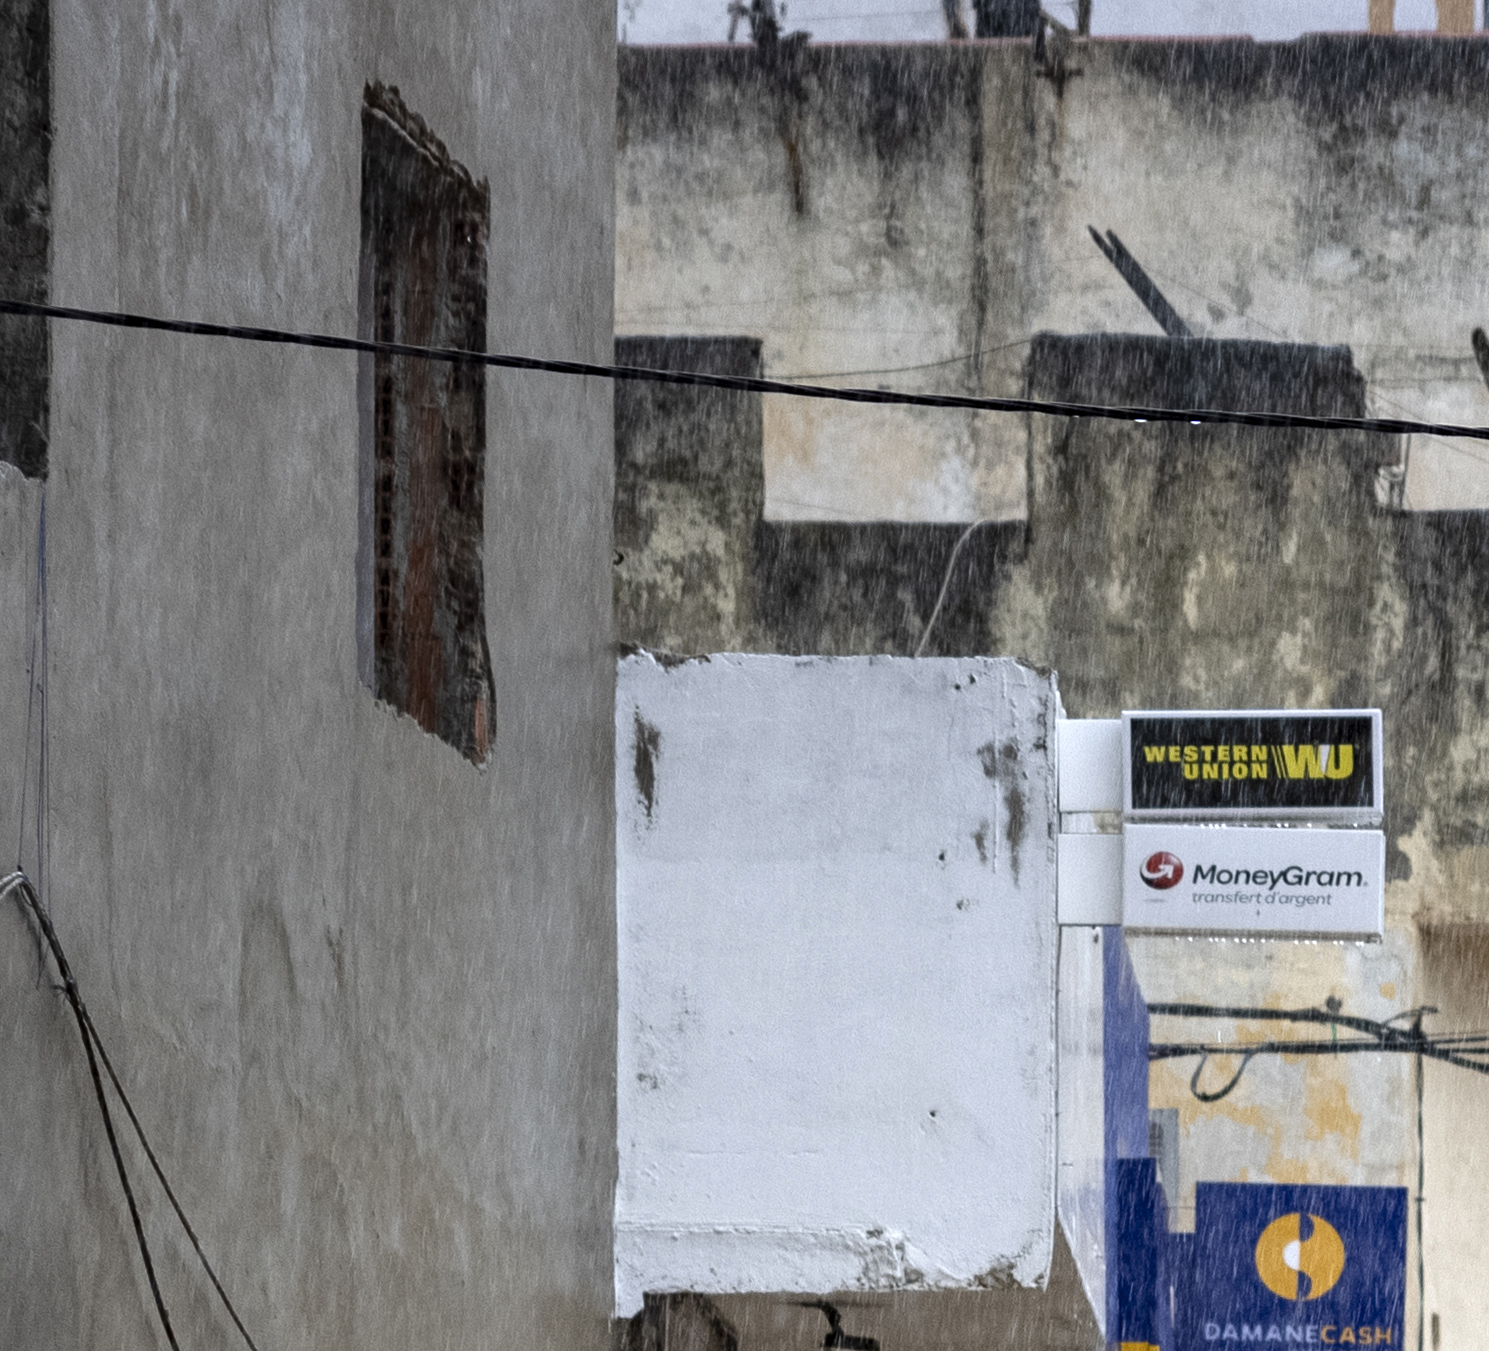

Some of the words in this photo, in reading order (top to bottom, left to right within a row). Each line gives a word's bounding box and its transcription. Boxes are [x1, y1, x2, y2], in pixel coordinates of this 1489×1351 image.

[1144, 745, 1267, 762] WESTERN
[1285, 744, 1354, 779] WU
[1183, 763, 1267, 779] UNION
[1192, 865, 1363, 890] MoneyGram
[1192, 890, 1262, 905] transfert
[1265, 891, 1332, 908] d'argent
